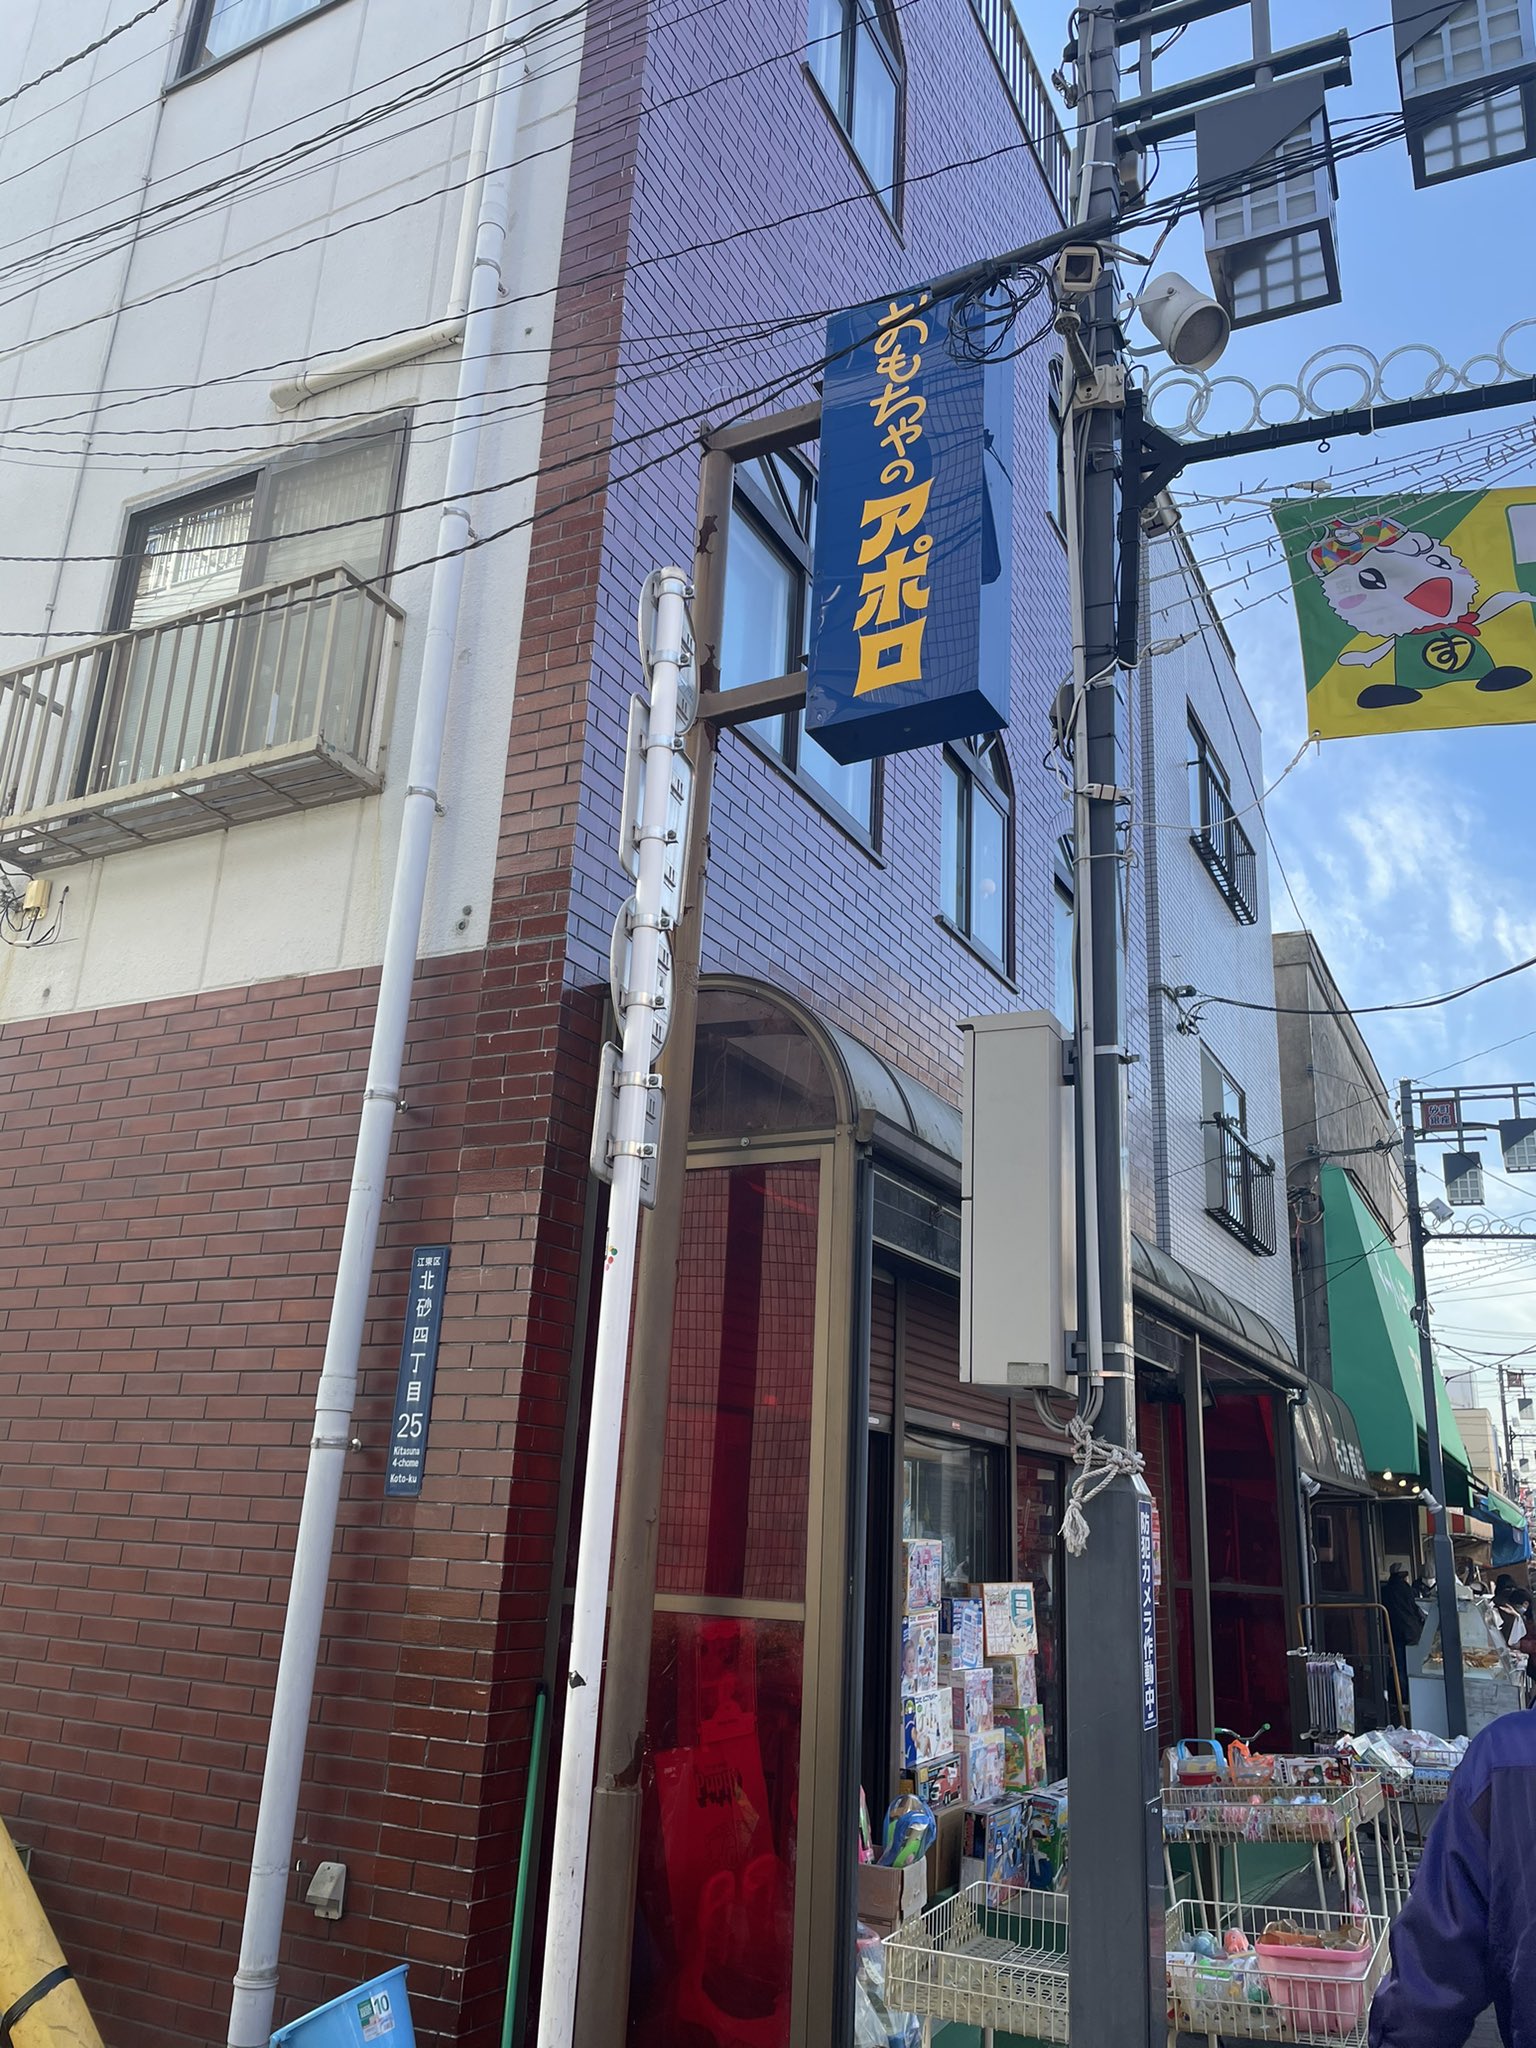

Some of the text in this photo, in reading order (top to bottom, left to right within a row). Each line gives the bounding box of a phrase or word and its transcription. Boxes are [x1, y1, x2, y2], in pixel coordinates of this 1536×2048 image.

[417, 1256, 441, 1267] 江東区
[396, 1270, 435, 1438] 北砂四丁目 25
[393, 1446, 420, 1456] Kitasuna
[392, 1458, 419, 1467] 4-chome
[390, 1473, 417, 1484] Koto-ku
[1140, 1512, 1154, 1711] 防犯カメラ作動中
[373, 1994, 390, 2015] 10
